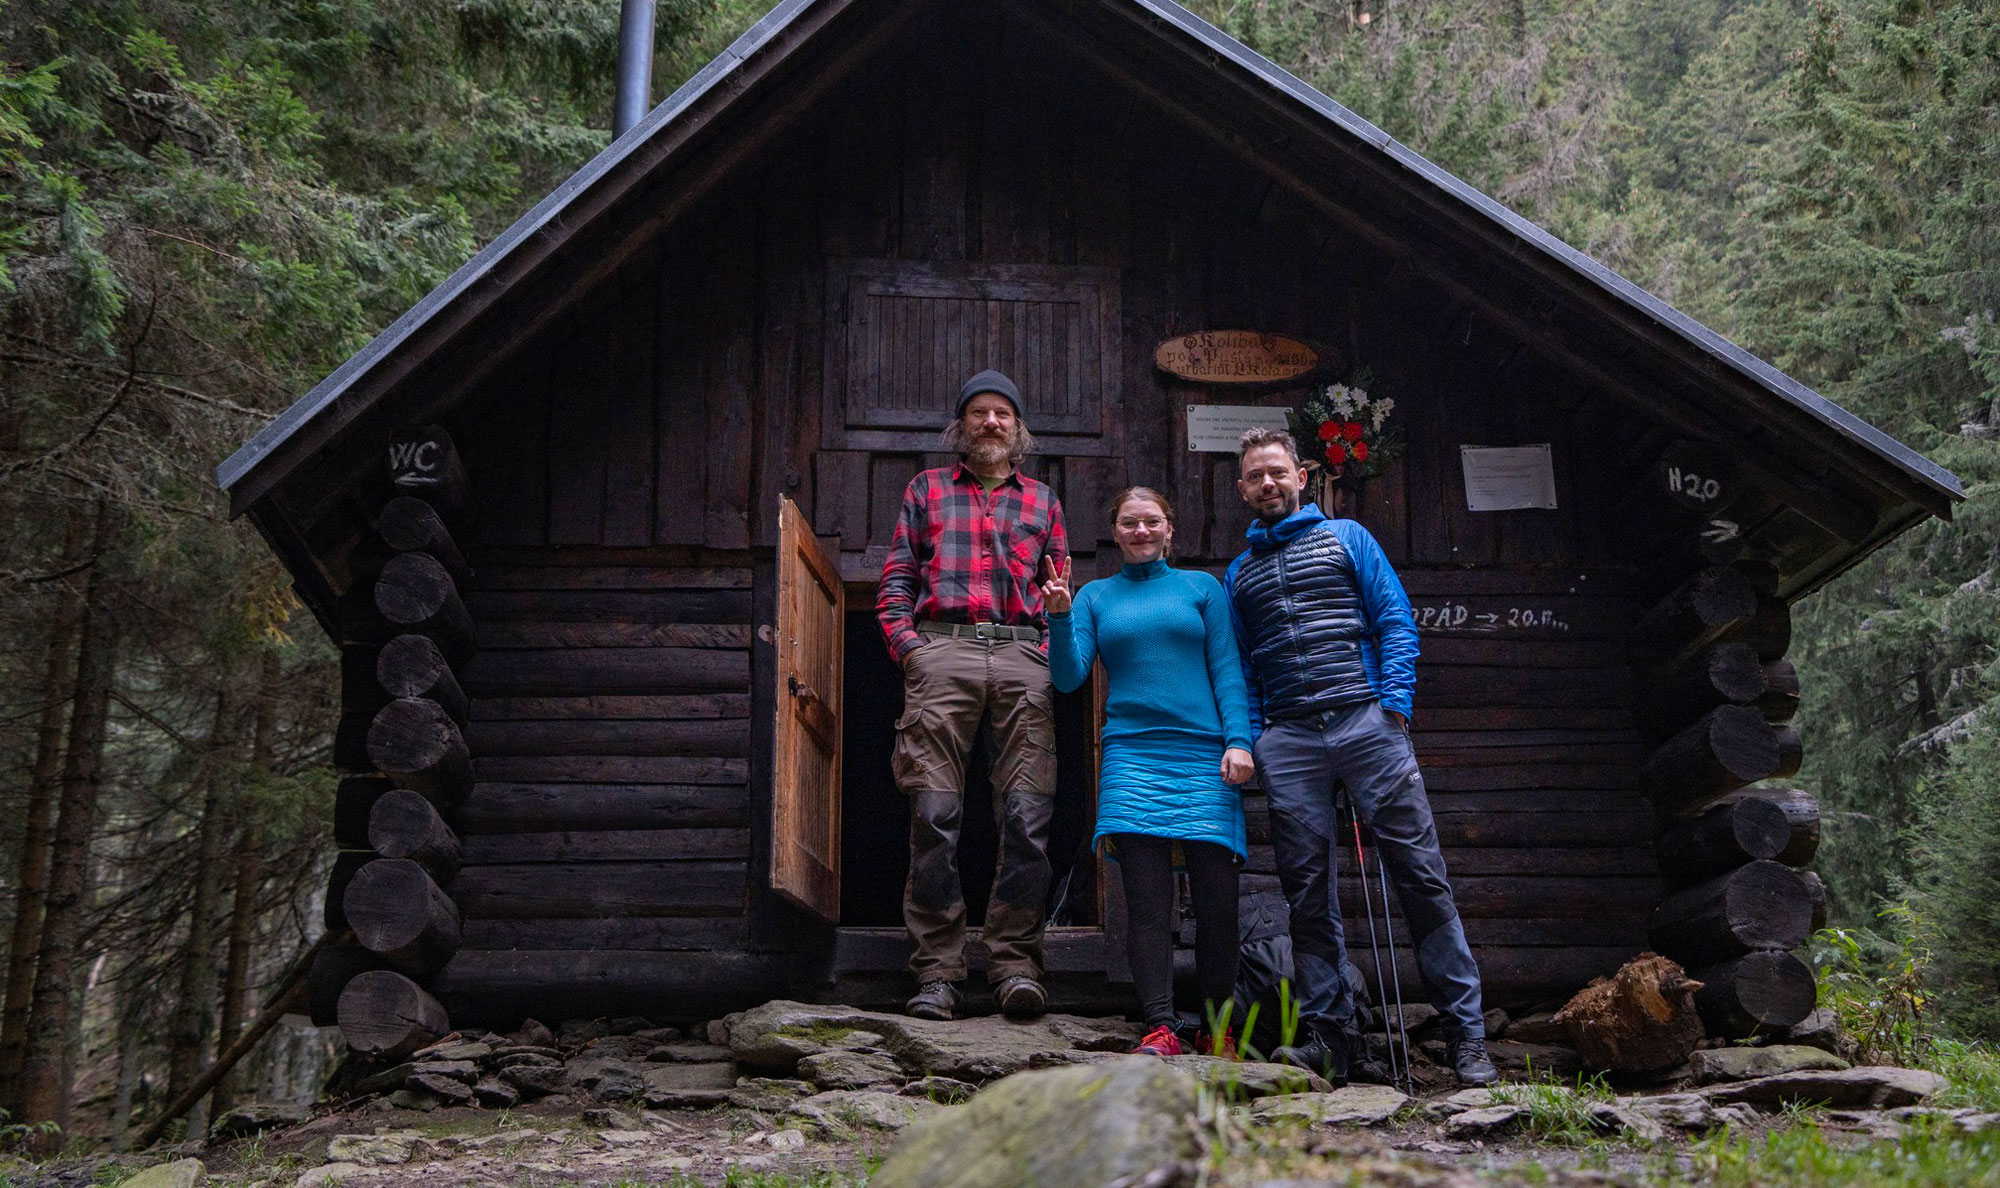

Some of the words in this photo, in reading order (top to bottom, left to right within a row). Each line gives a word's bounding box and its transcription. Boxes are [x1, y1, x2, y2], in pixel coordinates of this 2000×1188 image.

[1199, 333, 1259, 348] Koliba
[1166, 349, 1196, 368] pod
[389, 441, 440, 471] WC
